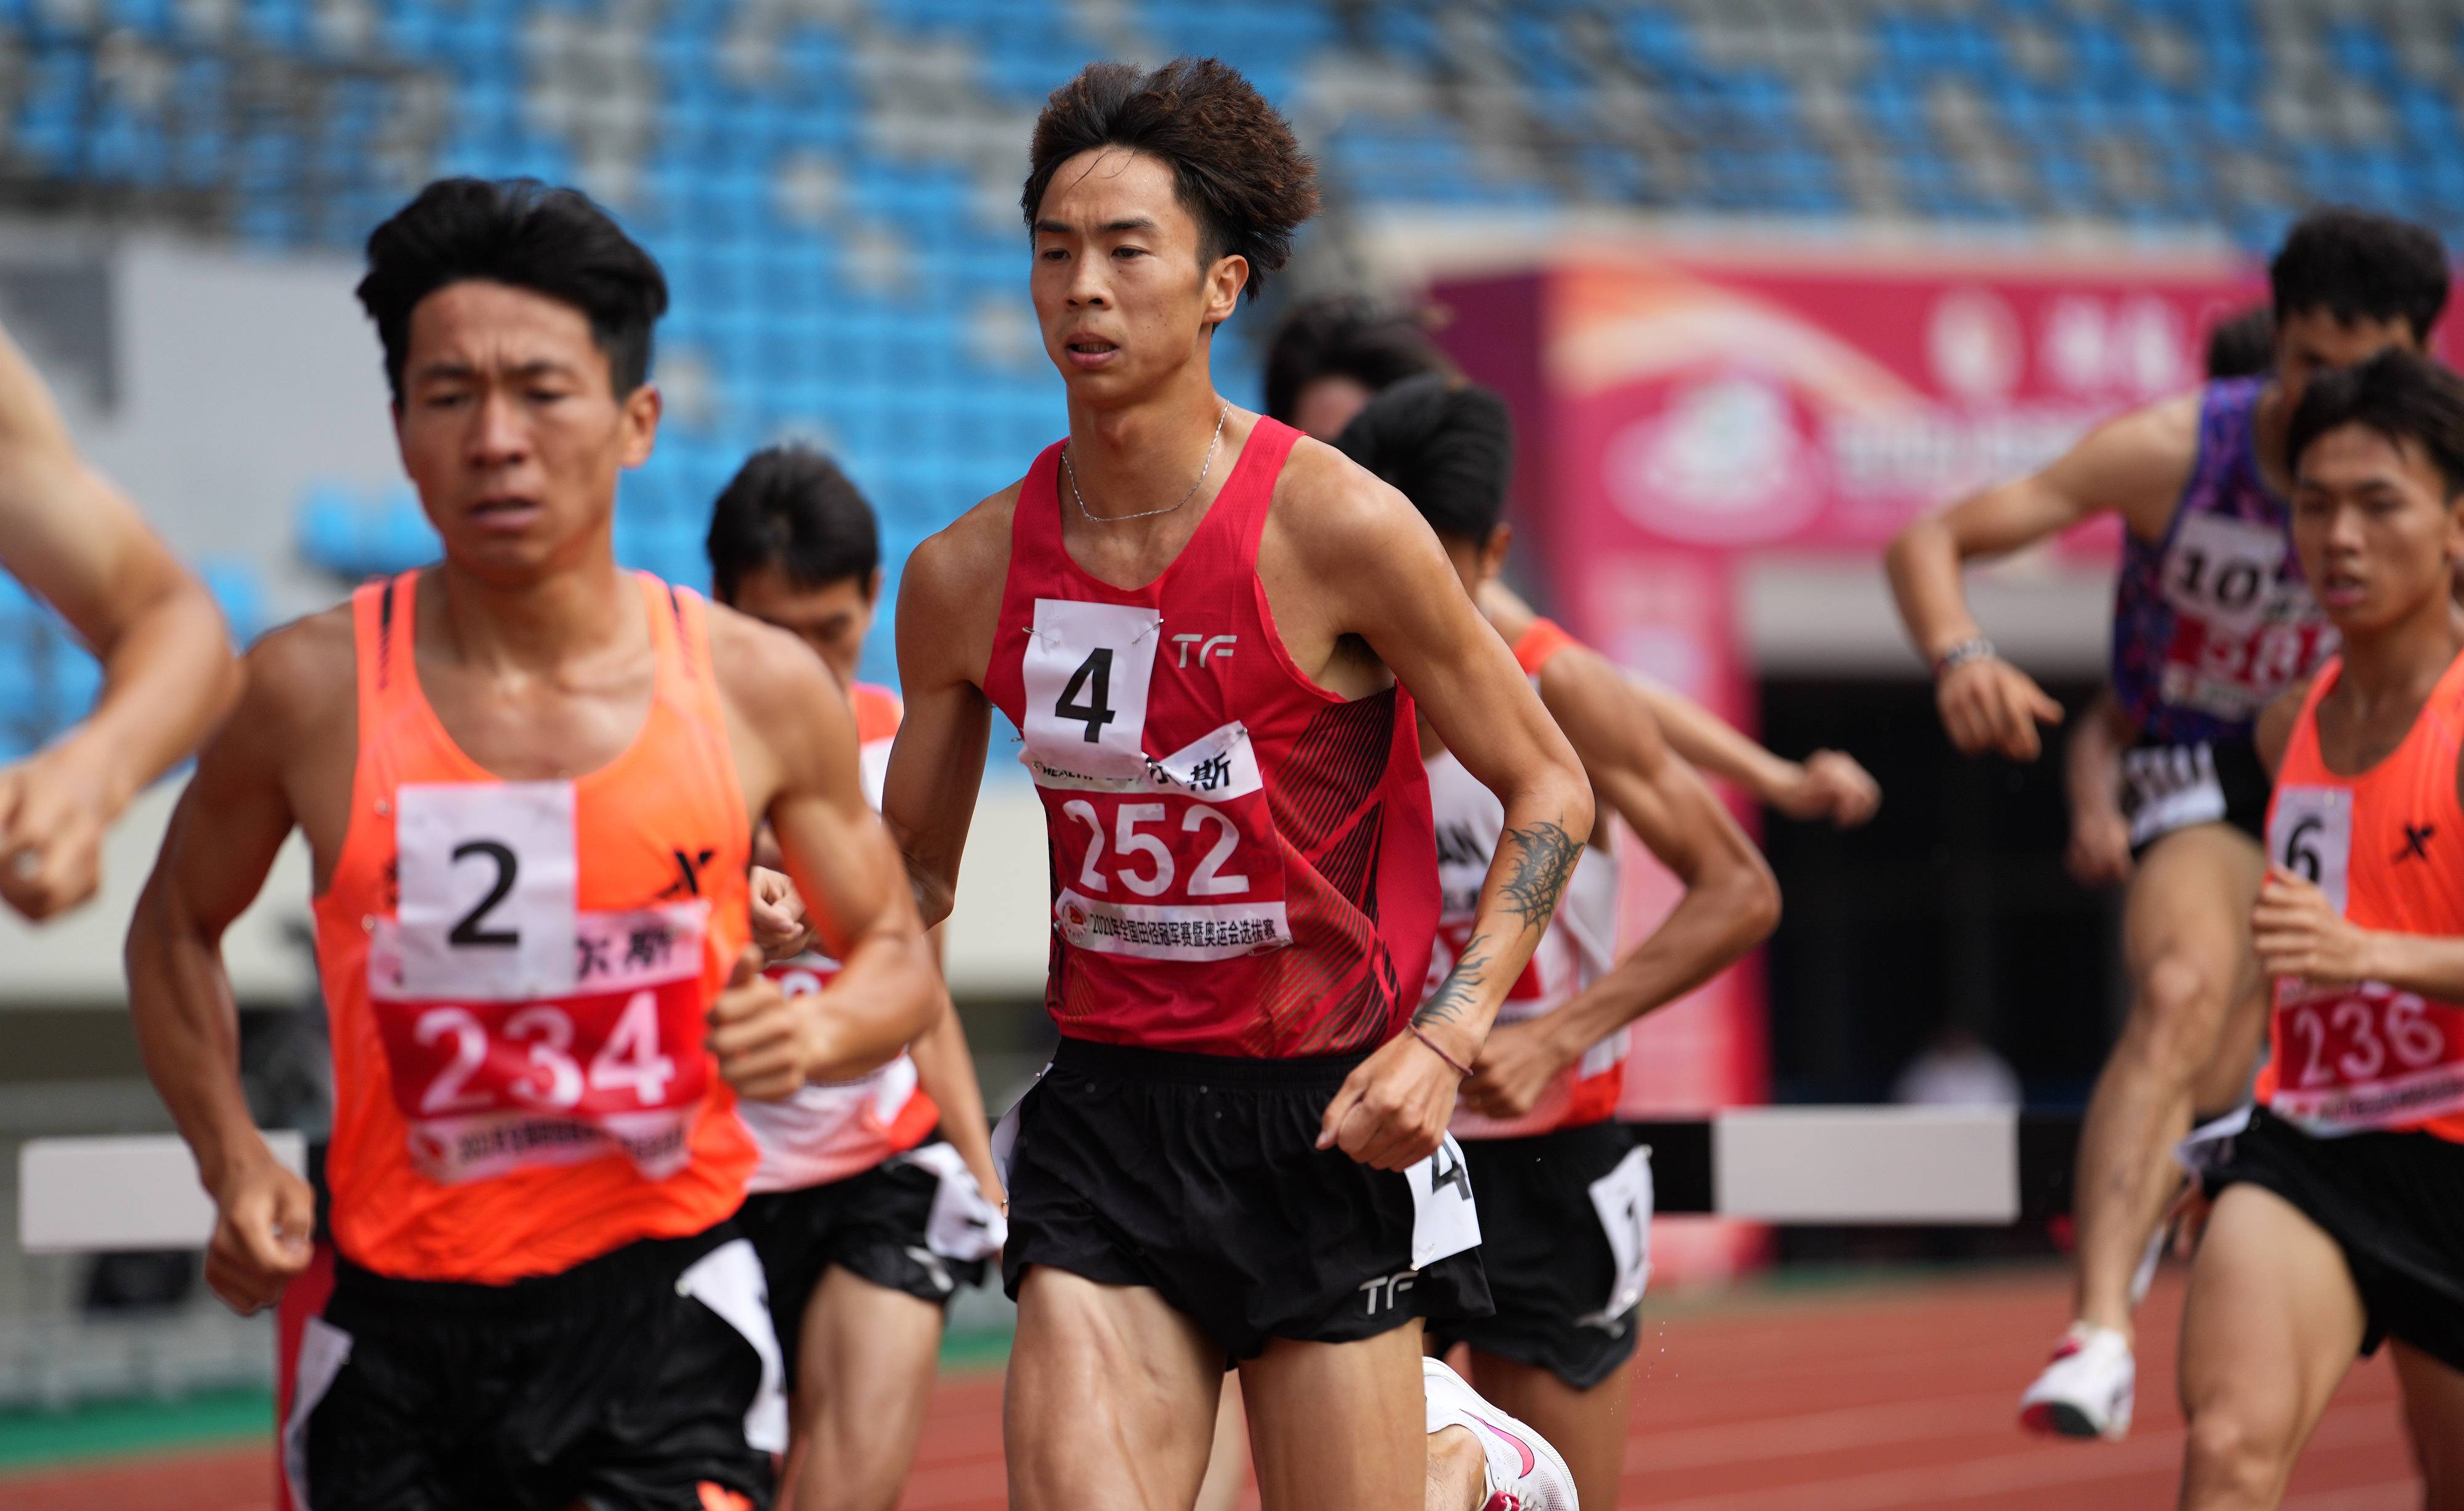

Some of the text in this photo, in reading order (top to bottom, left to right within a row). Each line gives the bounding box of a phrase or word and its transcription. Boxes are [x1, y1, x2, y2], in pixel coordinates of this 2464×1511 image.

[1055, 648, 1115, 743] 4
[1172, 633, 1238, 668] TF
[448, 840, 519, 948] 2
[1062, 800, 1250, 897] 252
[415, 990, 676, 1114] 234
[2292, 992, 2446, 1089] 236
